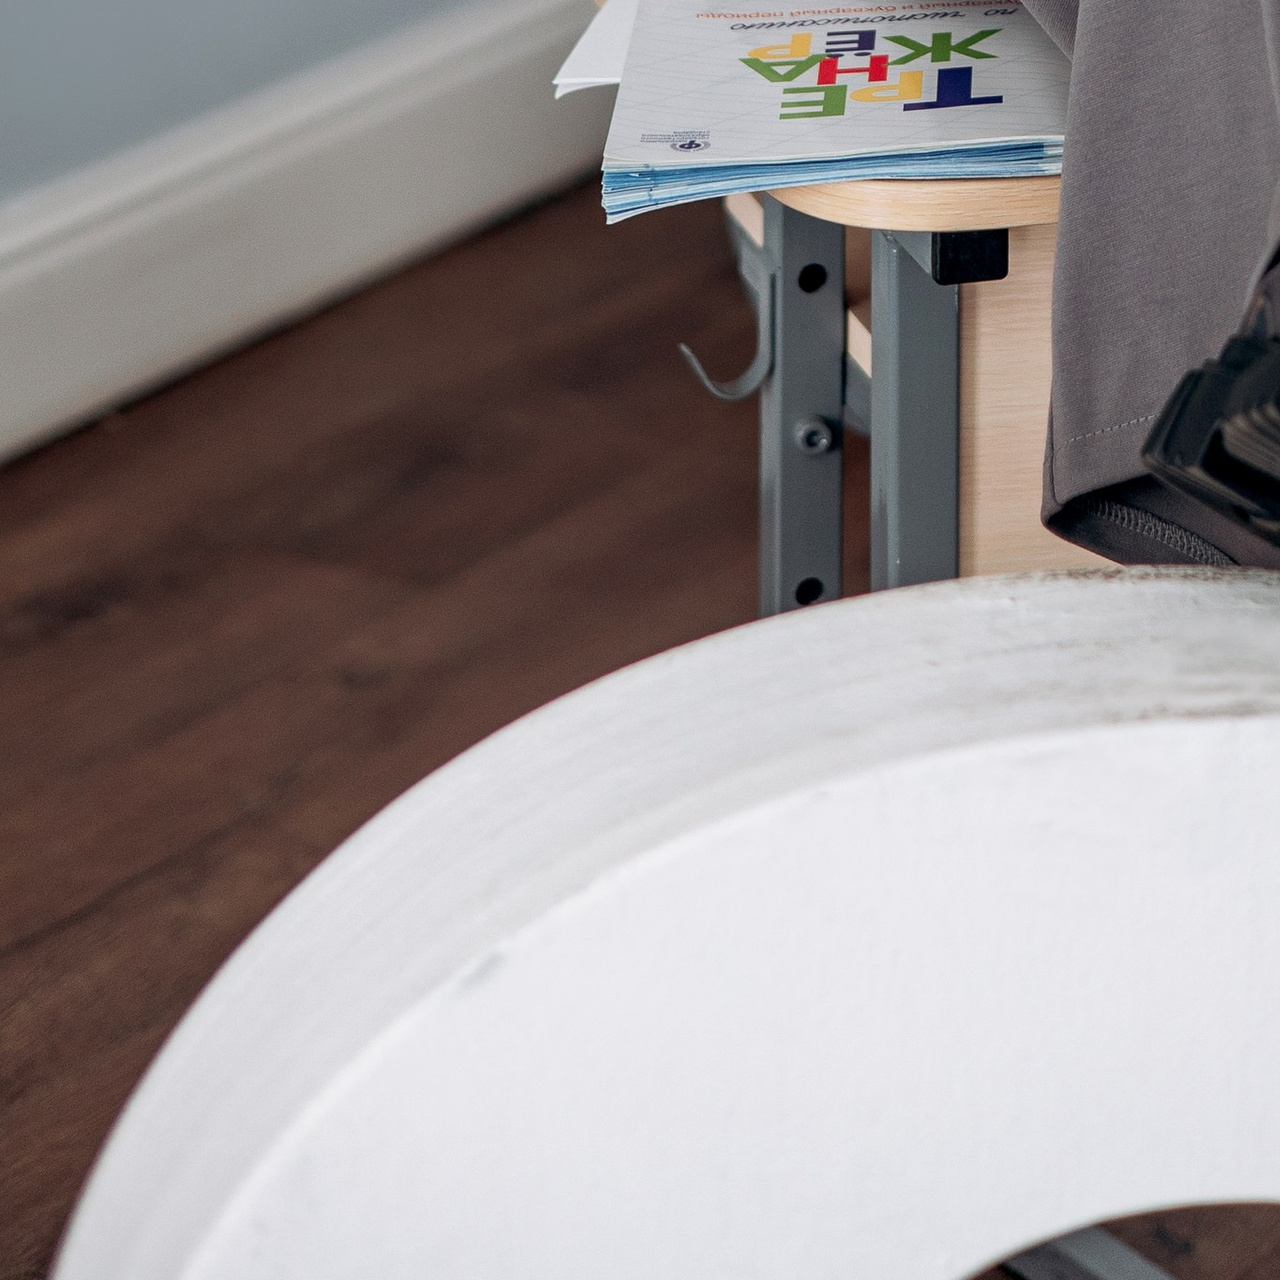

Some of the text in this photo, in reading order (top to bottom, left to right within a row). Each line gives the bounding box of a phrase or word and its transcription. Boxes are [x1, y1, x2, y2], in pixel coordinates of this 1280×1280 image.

[695, 8, 785, 19] периоды
[790, 4, 897, 17] букварный
[730, 7, 1019, 31] по чистописанию
